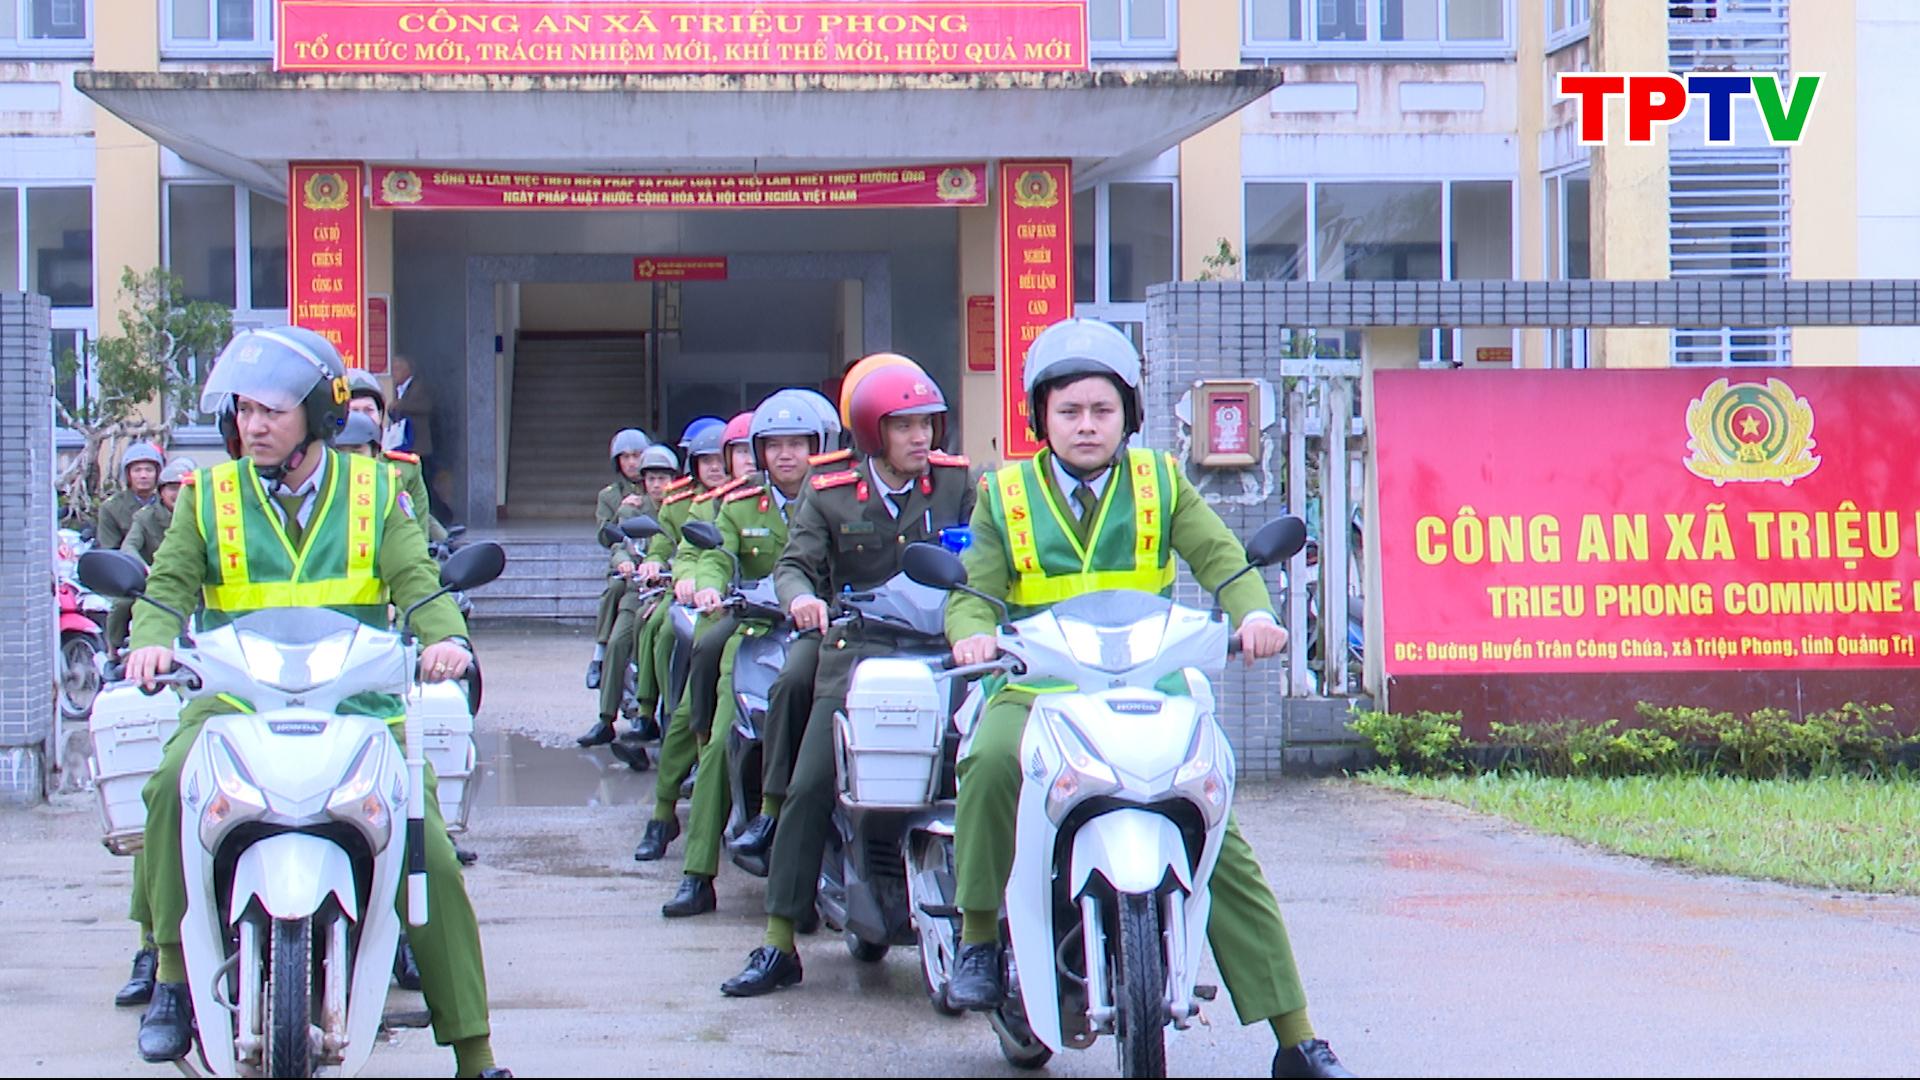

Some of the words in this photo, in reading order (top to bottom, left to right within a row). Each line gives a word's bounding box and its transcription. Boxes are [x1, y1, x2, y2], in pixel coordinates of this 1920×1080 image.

[398, 8, 519, 34] CÔNG
[535, 15, 590, 33] AN
[602, 10, 659, 33] XÃ
[671, 10, 804, 37] TRIỆU
[821, 15, 970, 33] PHONG
[294, 32, 330, 60] TỔ
[335, 38, 408, 61] CHỨC
[414, 39, 471, 64] MỚI,
[477, 39, 563, 61] TRÁCH
[570, 41, 655, 65] NHIỆM
[661, 40, 718, 64] MỚI,
[724, 39, 770, 61] KHÍ
[777, 35, 829, 61] THẾ
[832, 39, 890, 64] MỚI,
[897, 41, 958, 65] HIỆU
[964, 37, 1017, 64] QUẢ
[1024, 39, 1072, 60] MỚI
[537, 190, 569, 204] PHÁP
[571, 189, 600, 206] LUẬT
[637, 190, 669, 206] CỘNG
[716, 191, 736, 205] HỘI
[764, 189, 801, 203] NGHĨA
[802, 188, 828, 204] VIỆT
[829, 189, 858, 202] NAM
[333, 278, 344, 293] AN
[332, 303, 356, 318] PHONG
[1028, 299, 1049, 315] CAND
[1414, 505, 1562, 565] CÔNG
[1576, 513, 1650, 562] AN
[1664, 503, 1737, 562] XÃ
[1748, 500, 1900, 570] TRIỆU
[1486, 584, 1585, 619] TRIEU
[1595, 583, 1714, 617] PHONG
[1723, 580, 1904, 615] COMMUNE
[1426, 640, 1479, 662] Đường
[1536, 639, 1573, 659] Trân
[1576, 638, 1618, 659] Công
[1621, 638, 1668, 659] Chúa,
[1672, 637, 1692, 656] xã
[1695, 637, 1738, 660] Triệu
[1741, 636, 1799, 657] Phong,
[1801, 634, 1834, 655] tỉnh
[1837, 633, 1889, 656] Quảng
[1891, 634, 1915, 657] Trị
